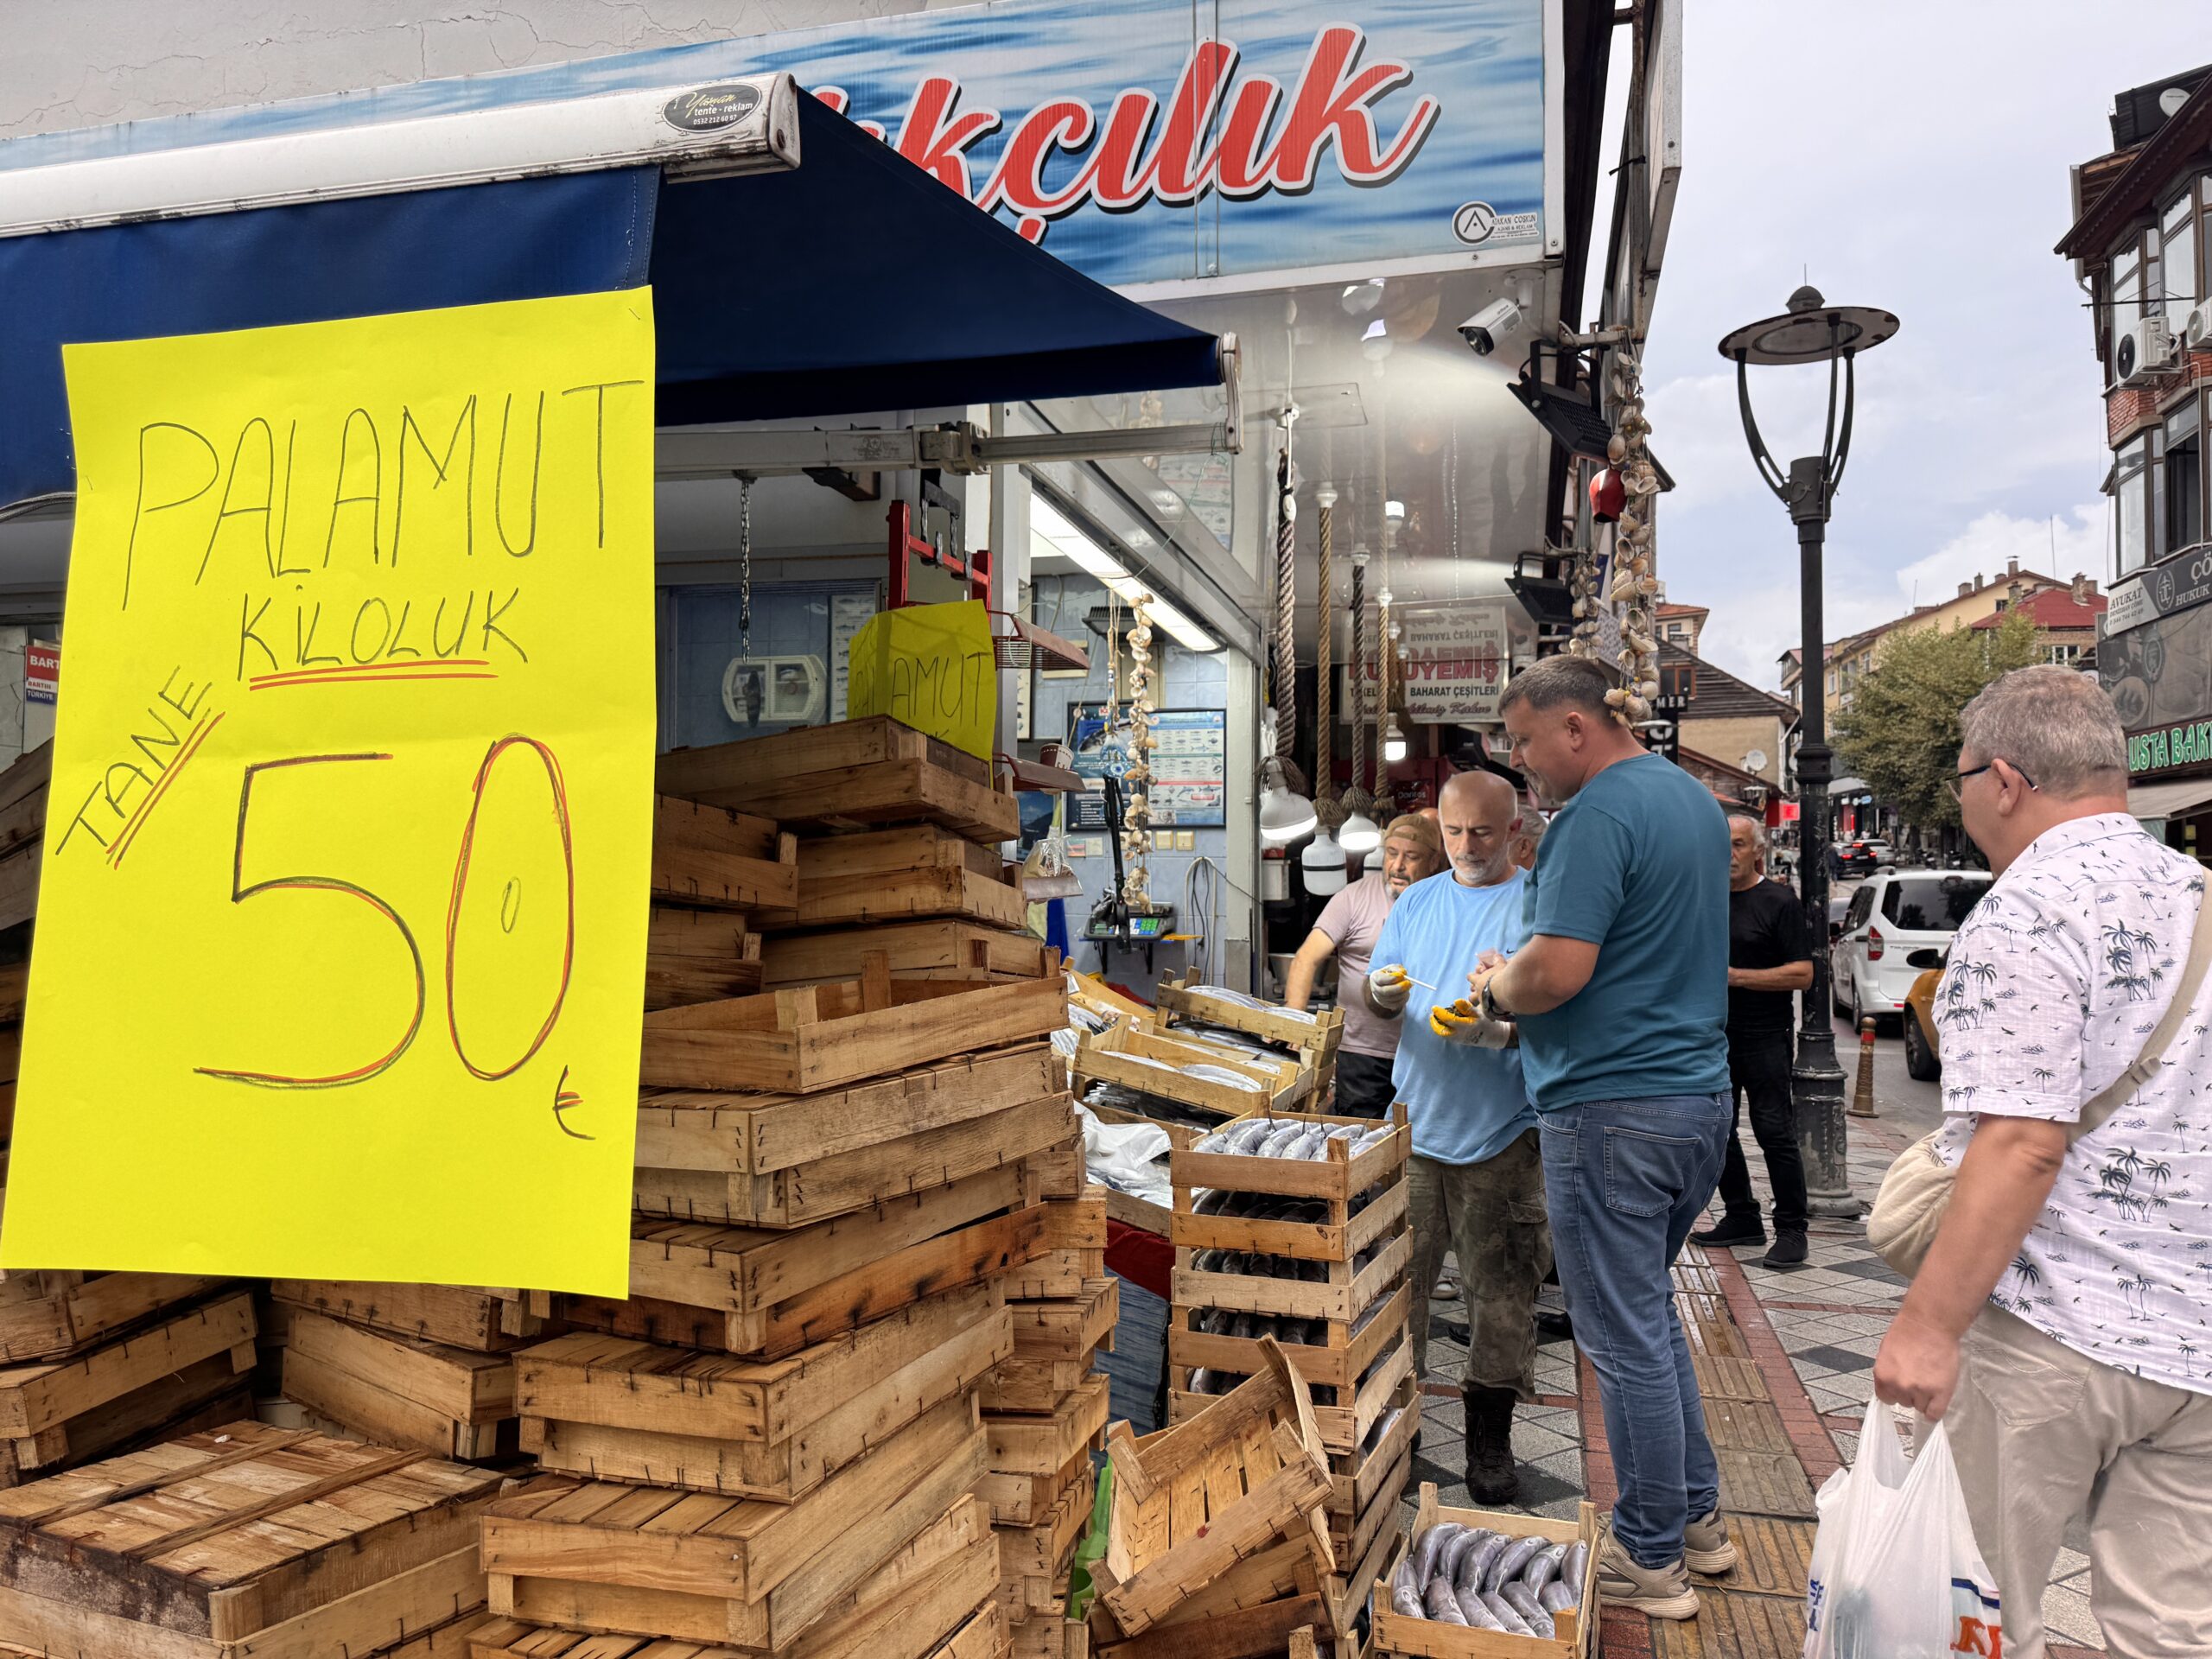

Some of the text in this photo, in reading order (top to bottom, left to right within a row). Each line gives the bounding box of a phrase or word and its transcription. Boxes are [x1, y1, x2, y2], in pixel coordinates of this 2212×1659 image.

[675, 92, 737, 118] Yaman
[694, 106, 717, 116] tente
[723, 103, 753, 112] reklam
[812, 22, 1440, 245] kçılık
[123, 380, 645, 611] PALAMUT
[2110, 587, 2143, 610] AVUKAT
[2175, 583, 2210, 607] HUKUK
[238, 584, 528, 681] KİLOLUK
[1351, 685, 1499, 699] TKEL BAHARAT ÇEŞİTLERİ
[56, 666, 213, 855] TANE
[2128, 729, 2170, 772] USTA
[193, 733, 574, 1090] 50
